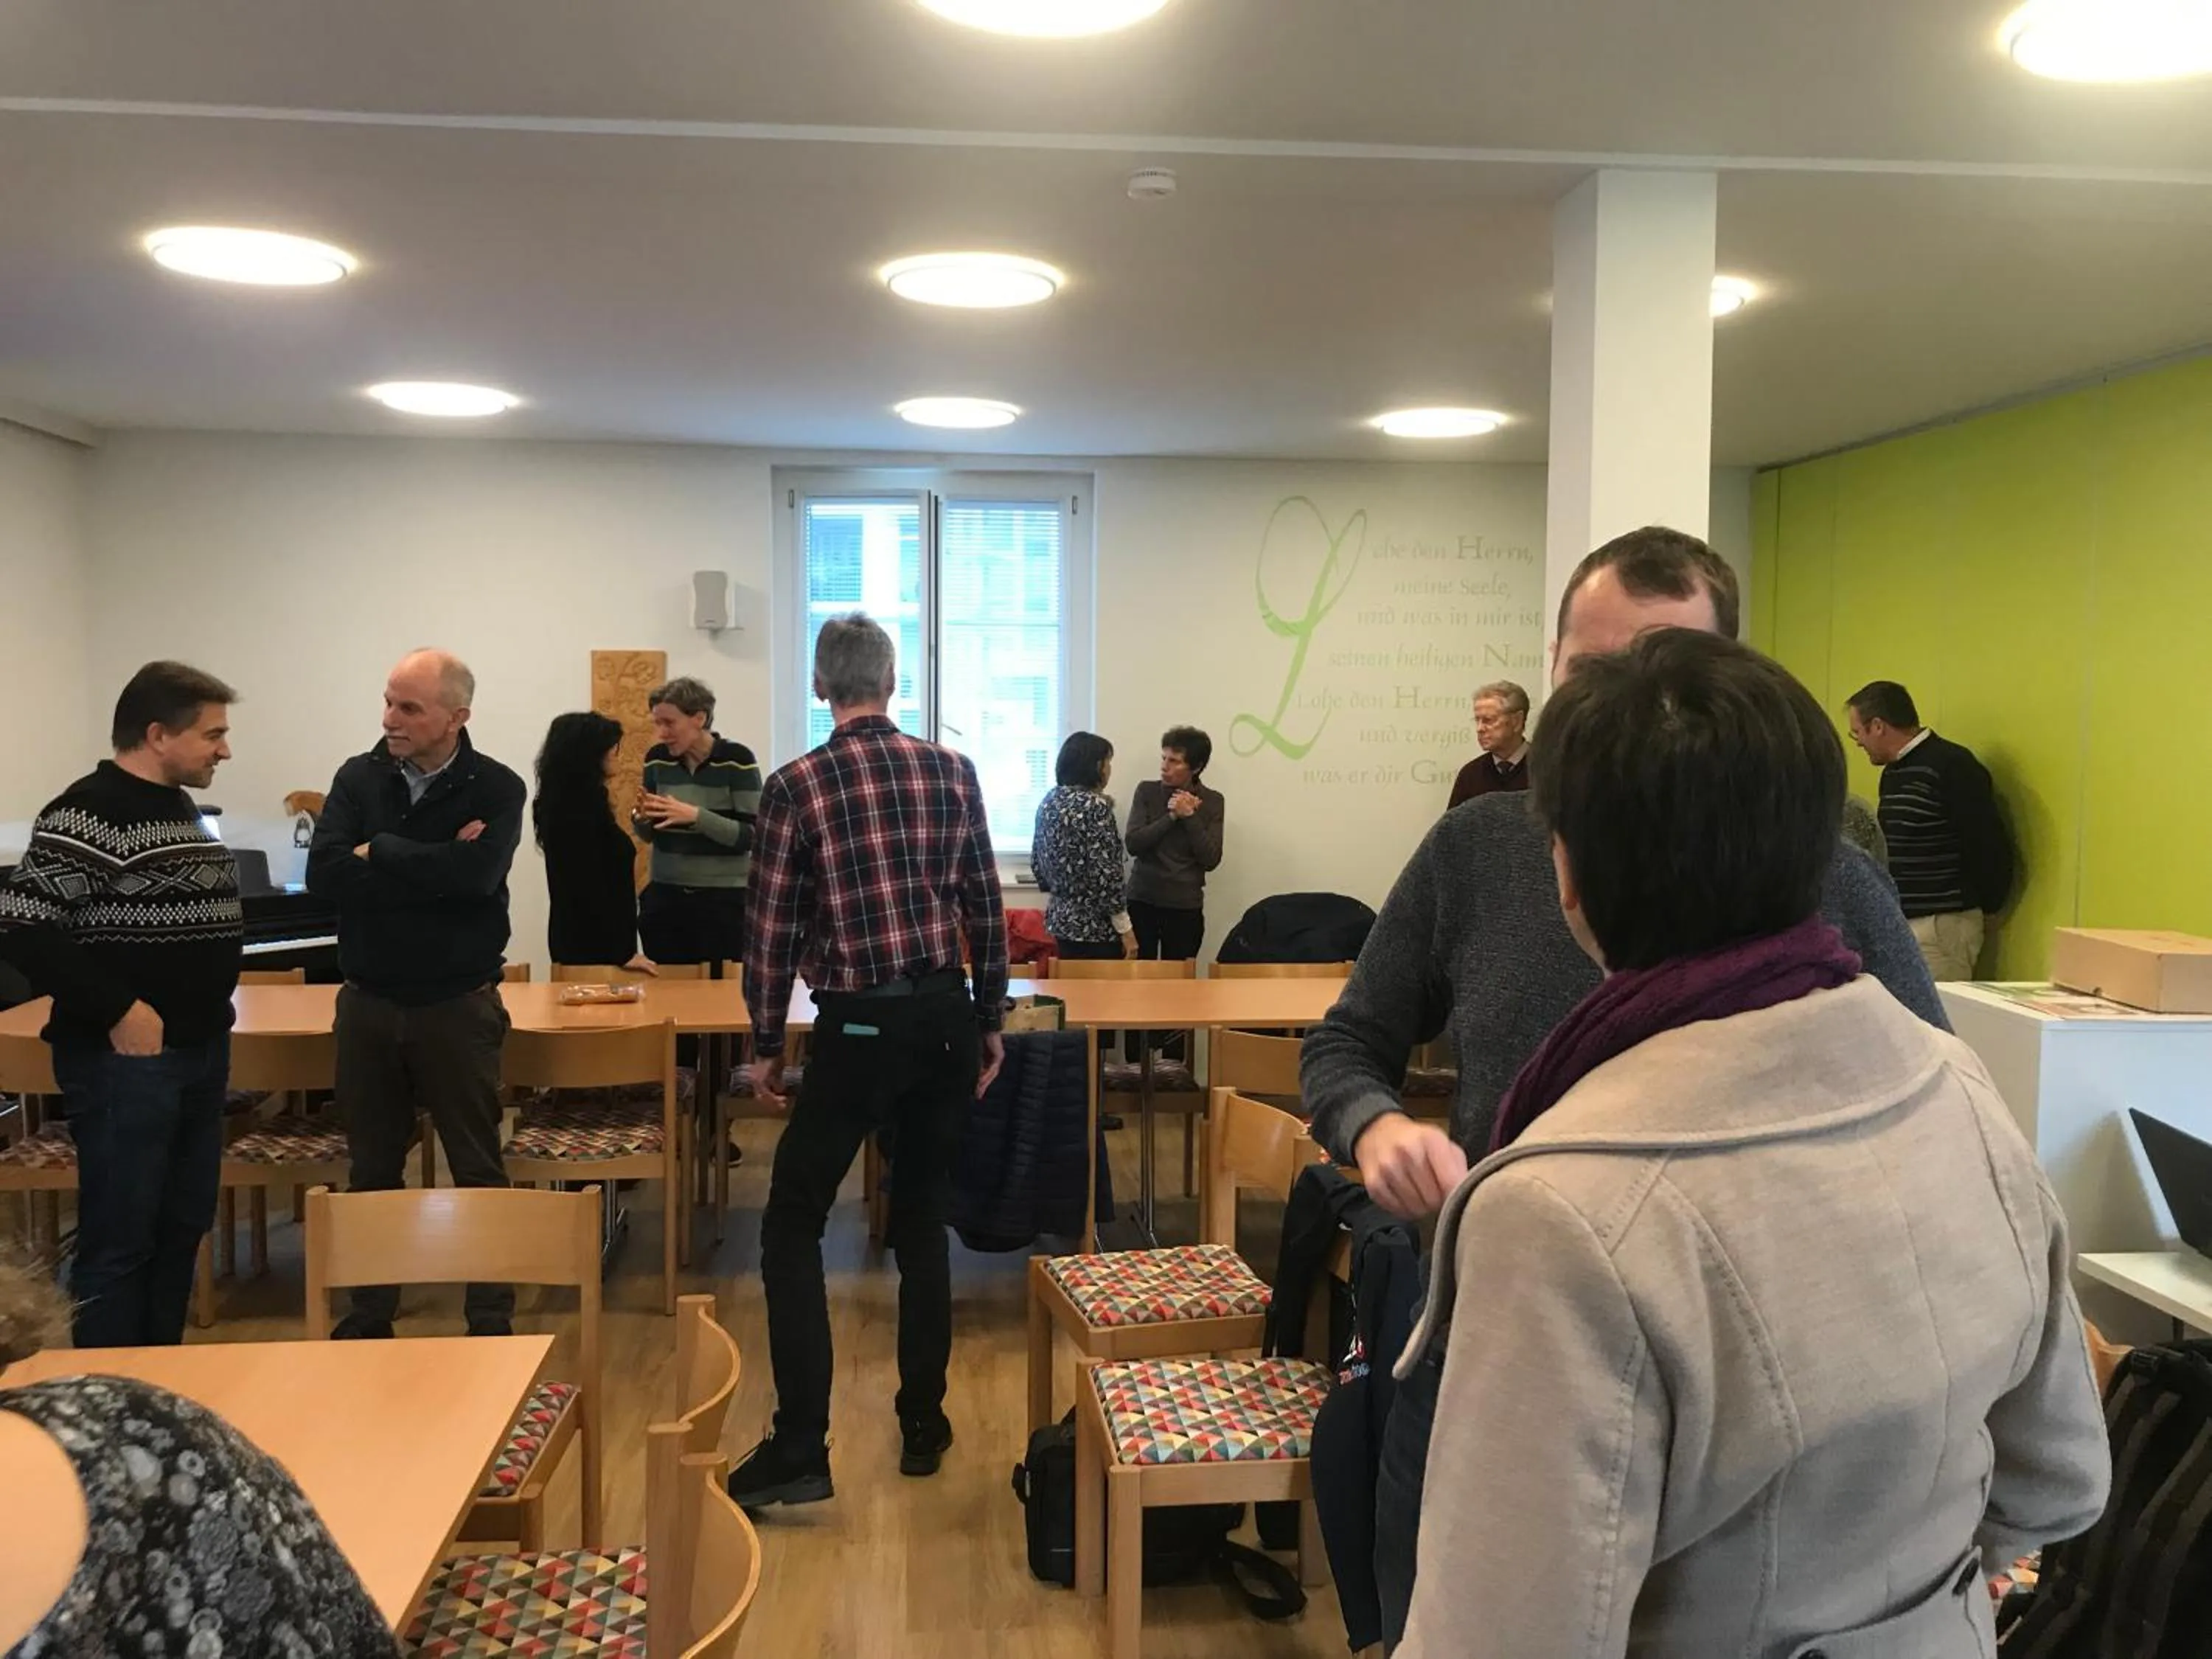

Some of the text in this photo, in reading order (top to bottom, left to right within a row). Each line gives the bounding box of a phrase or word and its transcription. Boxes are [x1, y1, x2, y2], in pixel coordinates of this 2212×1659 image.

[1394, 574, 1453, 594] meine
[1357, 606, 1394, 626] und
[1402, 610, 1442, 626] was
[1450, 605, 1468, 626] in
[1476, 605, 1511, 626] mir
[1359, 724, 1397, 743] und
[1303, 768, 1341, 785] was
